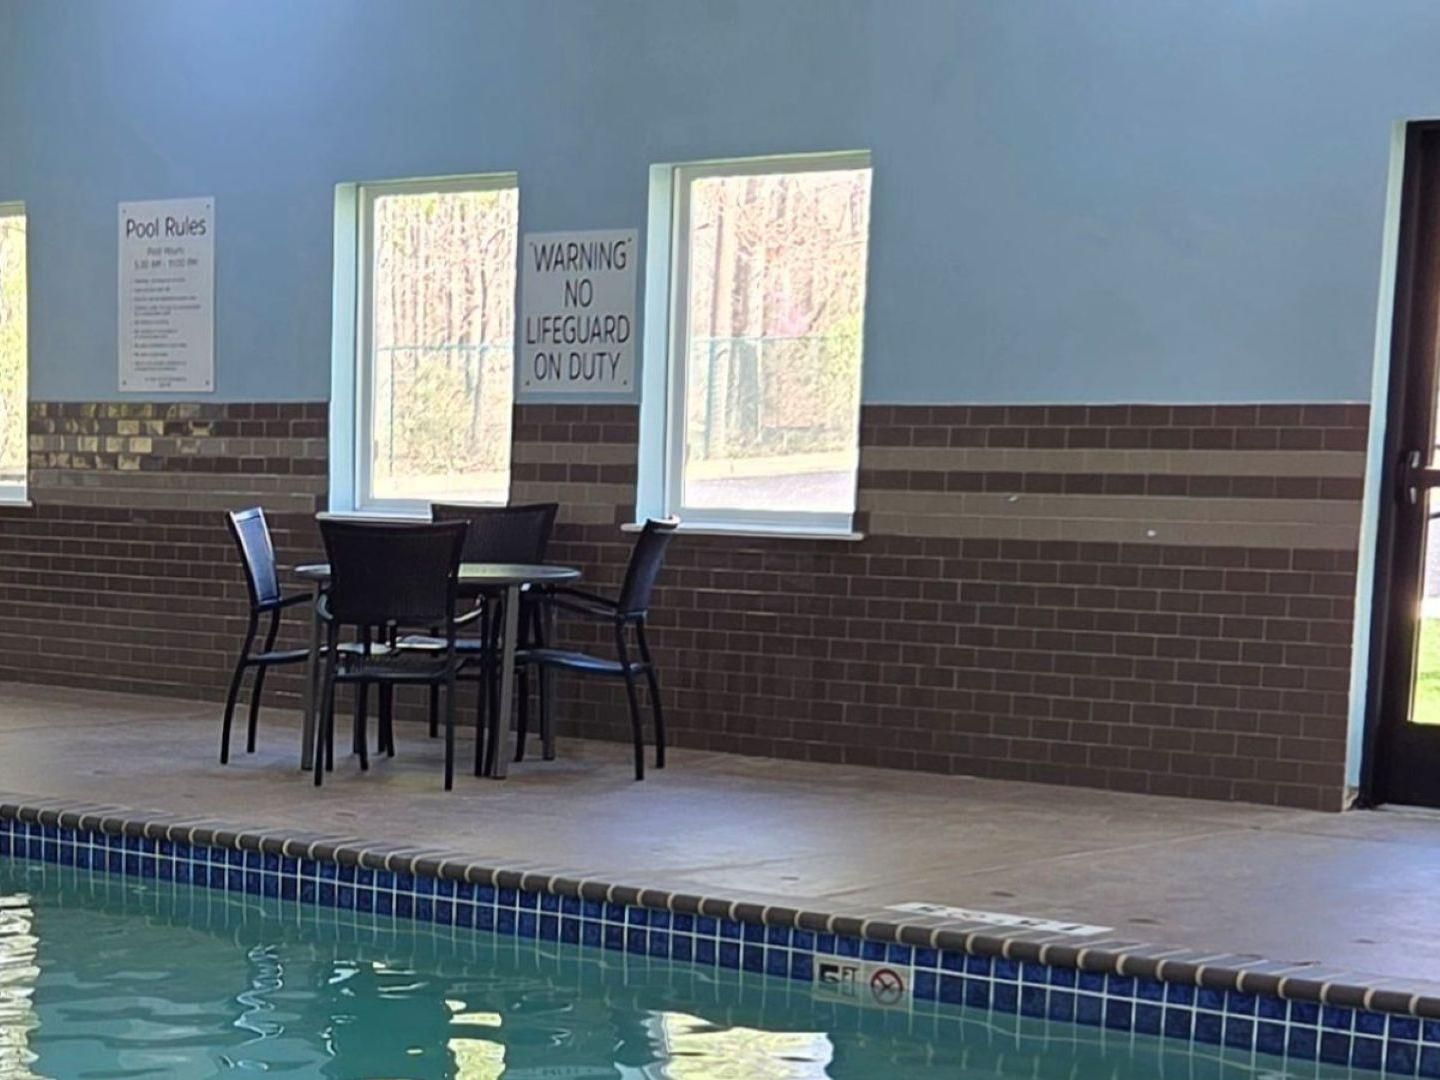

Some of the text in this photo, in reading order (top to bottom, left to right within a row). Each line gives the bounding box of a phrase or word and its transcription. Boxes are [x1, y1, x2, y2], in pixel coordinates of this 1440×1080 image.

[126, 215, 207, 238] Pool Rules
[534, 240, 627, 272] WARNING
[564, 278, 593, 308] NO
[526, 314, 631, 344] LIFEGUARD
[534, 352, 621, 381] ON DUTY
